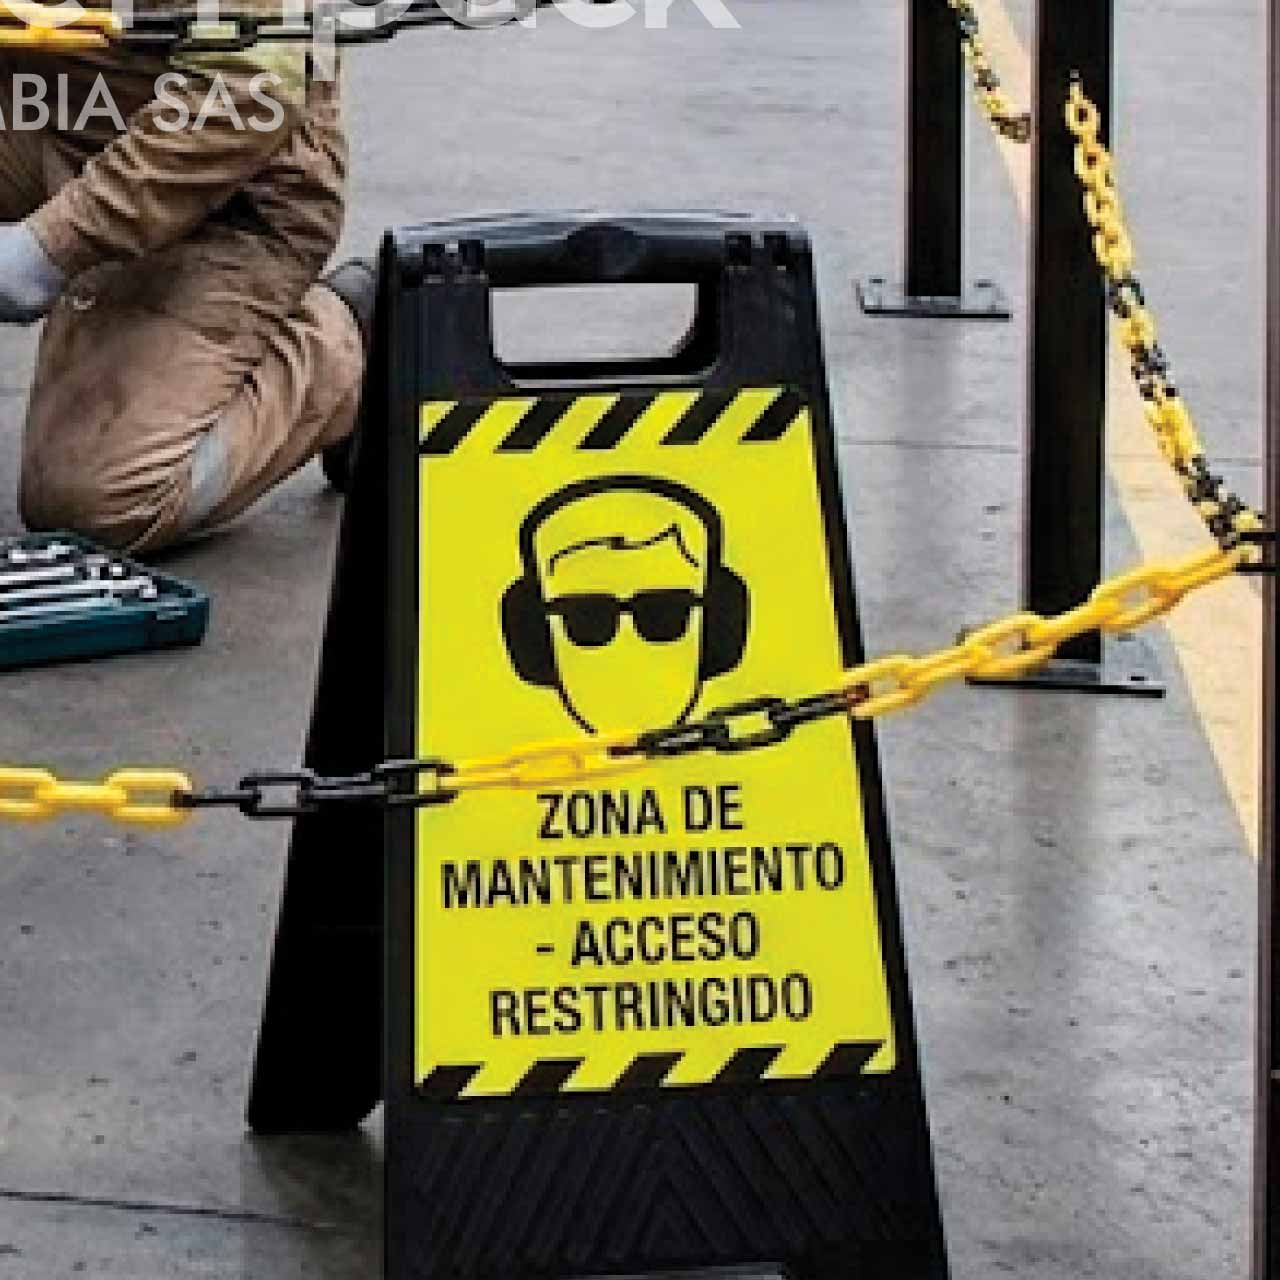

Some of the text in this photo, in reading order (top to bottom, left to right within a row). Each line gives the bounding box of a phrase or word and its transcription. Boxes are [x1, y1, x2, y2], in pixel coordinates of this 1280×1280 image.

[536, 783, 744, 839] ZONA DE
[440, 842, 845, 909] MANTENIMIENTO
[571, 911, 761, 966] ACCESO
[489, 972, 813, 1038] RESTRINGIDO
